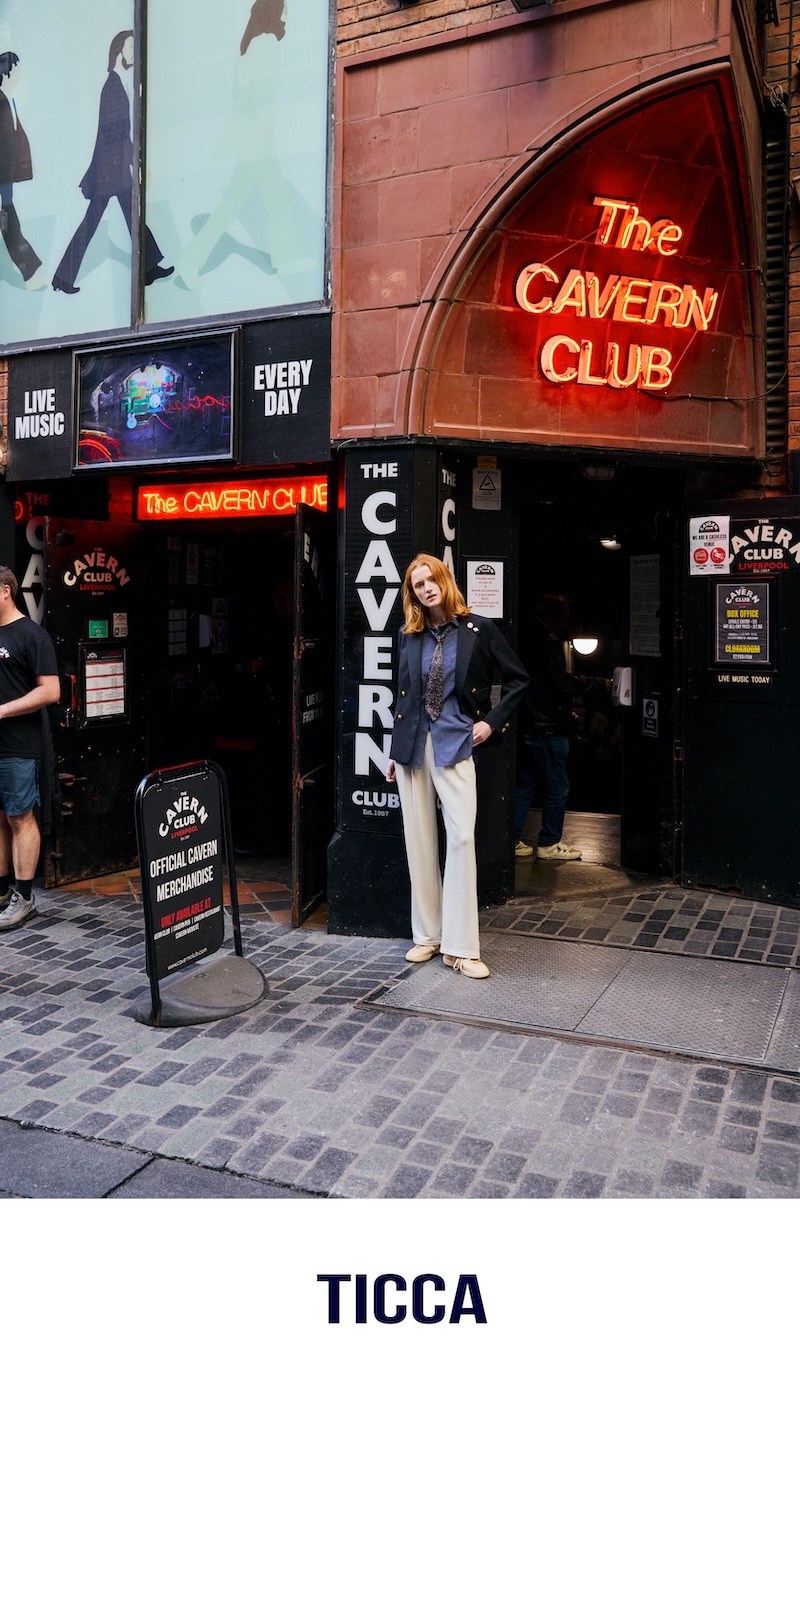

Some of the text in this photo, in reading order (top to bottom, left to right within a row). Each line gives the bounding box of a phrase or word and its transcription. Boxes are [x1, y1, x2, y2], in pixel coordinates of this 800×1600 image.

[593, 196, 683, 256] The
[515, 262, 719, 331] CAVERN
[540, 334, 673, 391] CLUB
[254, 359, 313, 391] EVERY
[24, 388, 56, 414] LIVE
[264, 388, 302, 417] DAY
[14, 412, 65, 439] MUSIC
[360, 462, 399, 478] THE
[441, 468, 457, 487] THE
[25, 491, 51, 507] THE
[143, 493, 178, 514] The
[184, 489, 269, 513] CAVERN
[744, 548, 784, 560] CLUB
[64, 552, 130, 586] CAVERN
[738, 562, 790, 570] LIVERPOOL
[83, 572, 113, 582] CLUB
[80, 583, 116, 591] LIVERPOOL
[725, 588, 761, 605] CAVERN
[726, 610, 760, 618] BOX OFFICE
[725, 644, 761, 653] CLOAKROOM
[718, 674, 771, 684] LIVE MUSIC TODAY
[352, 790, 400, 808] CLUB
[159, 795, 209, 837] CAVERN
[173, 814, 196, 829] CLUB
[171, 825, 199, 839] LIVERPOOL
[150, 838, 218, 879] OFFICIAL CAVERN
[156, 865, 214, 902] MERCHANDISE
[161, 897, 212, 929] ONLY AVAILABLE AT
